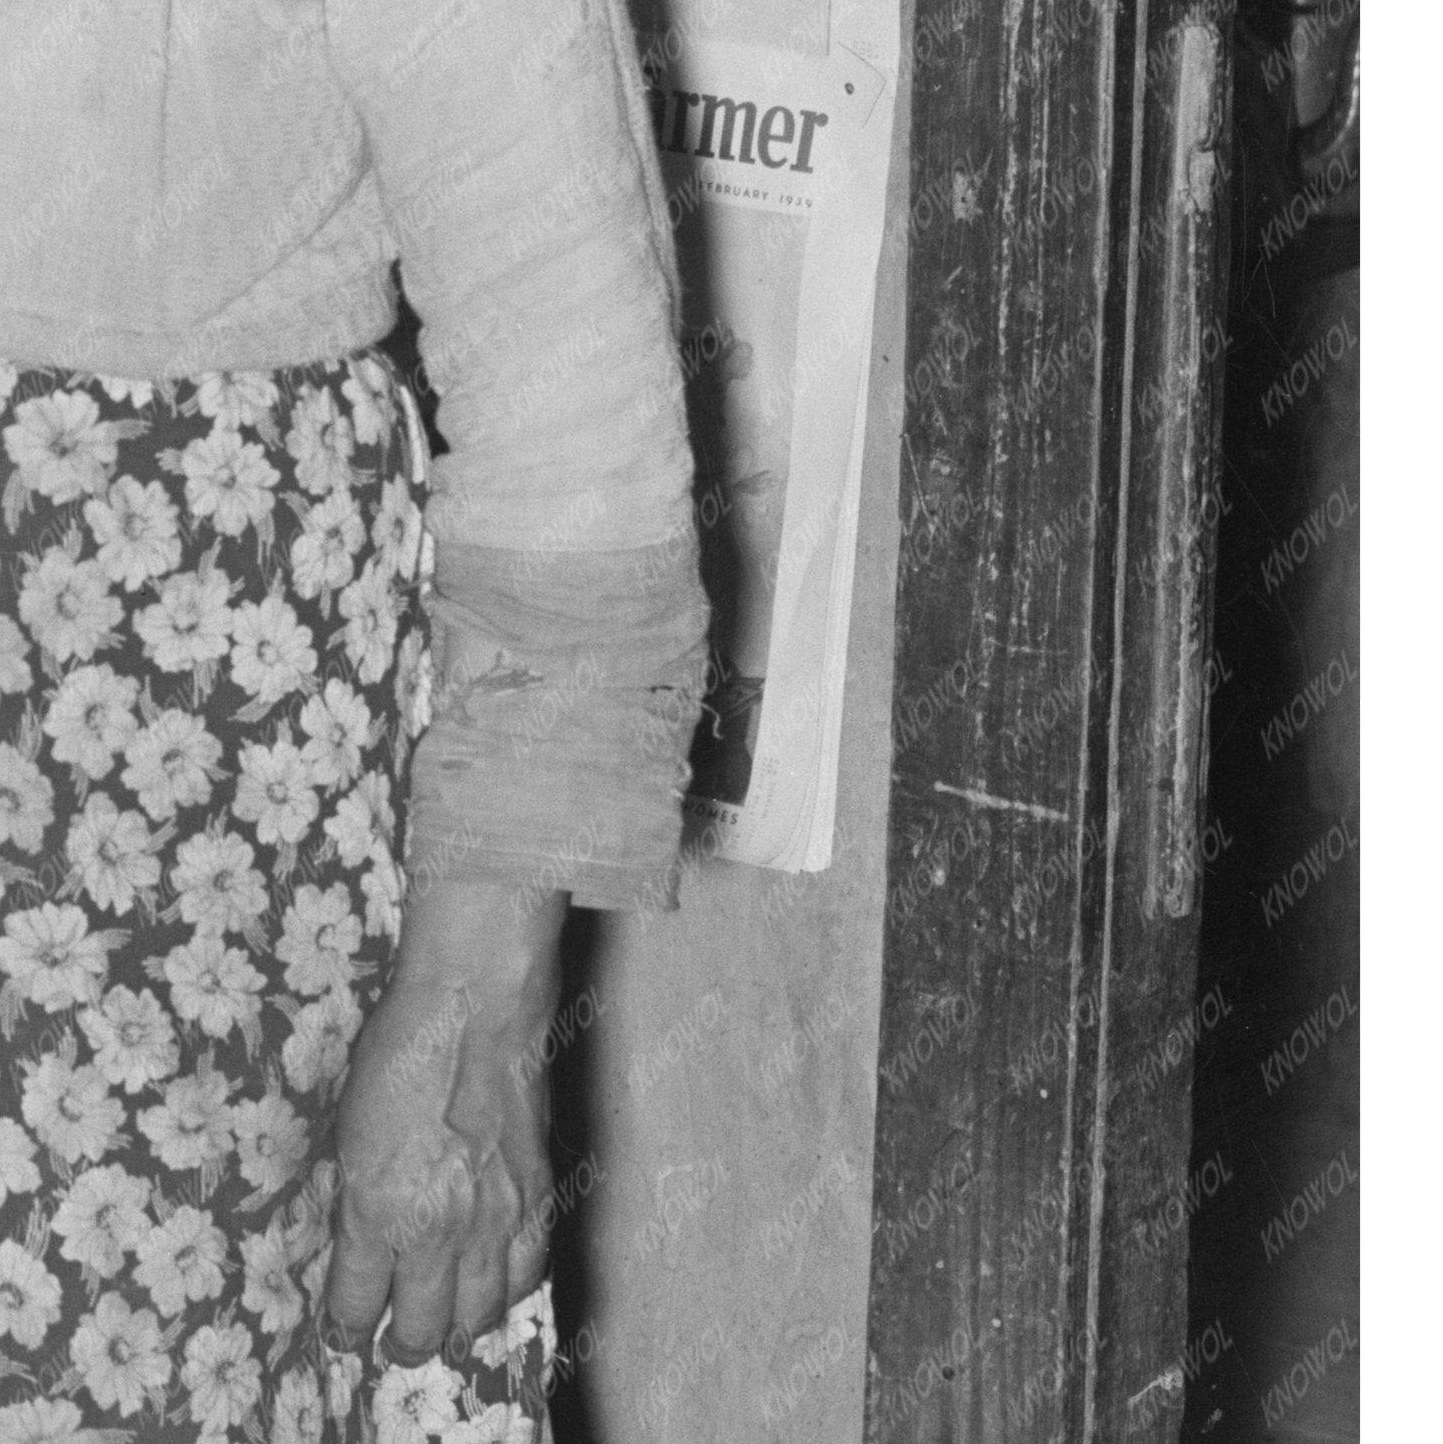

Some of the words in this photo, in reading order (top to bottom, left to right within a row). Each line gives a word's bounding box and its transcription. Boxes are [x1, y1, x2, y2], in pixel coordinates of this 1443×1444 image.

[649, 87, 829, 174] rmer
[698, 180, 769, 201] FEBRUARY
[779, 194, 812, 208] 1939
